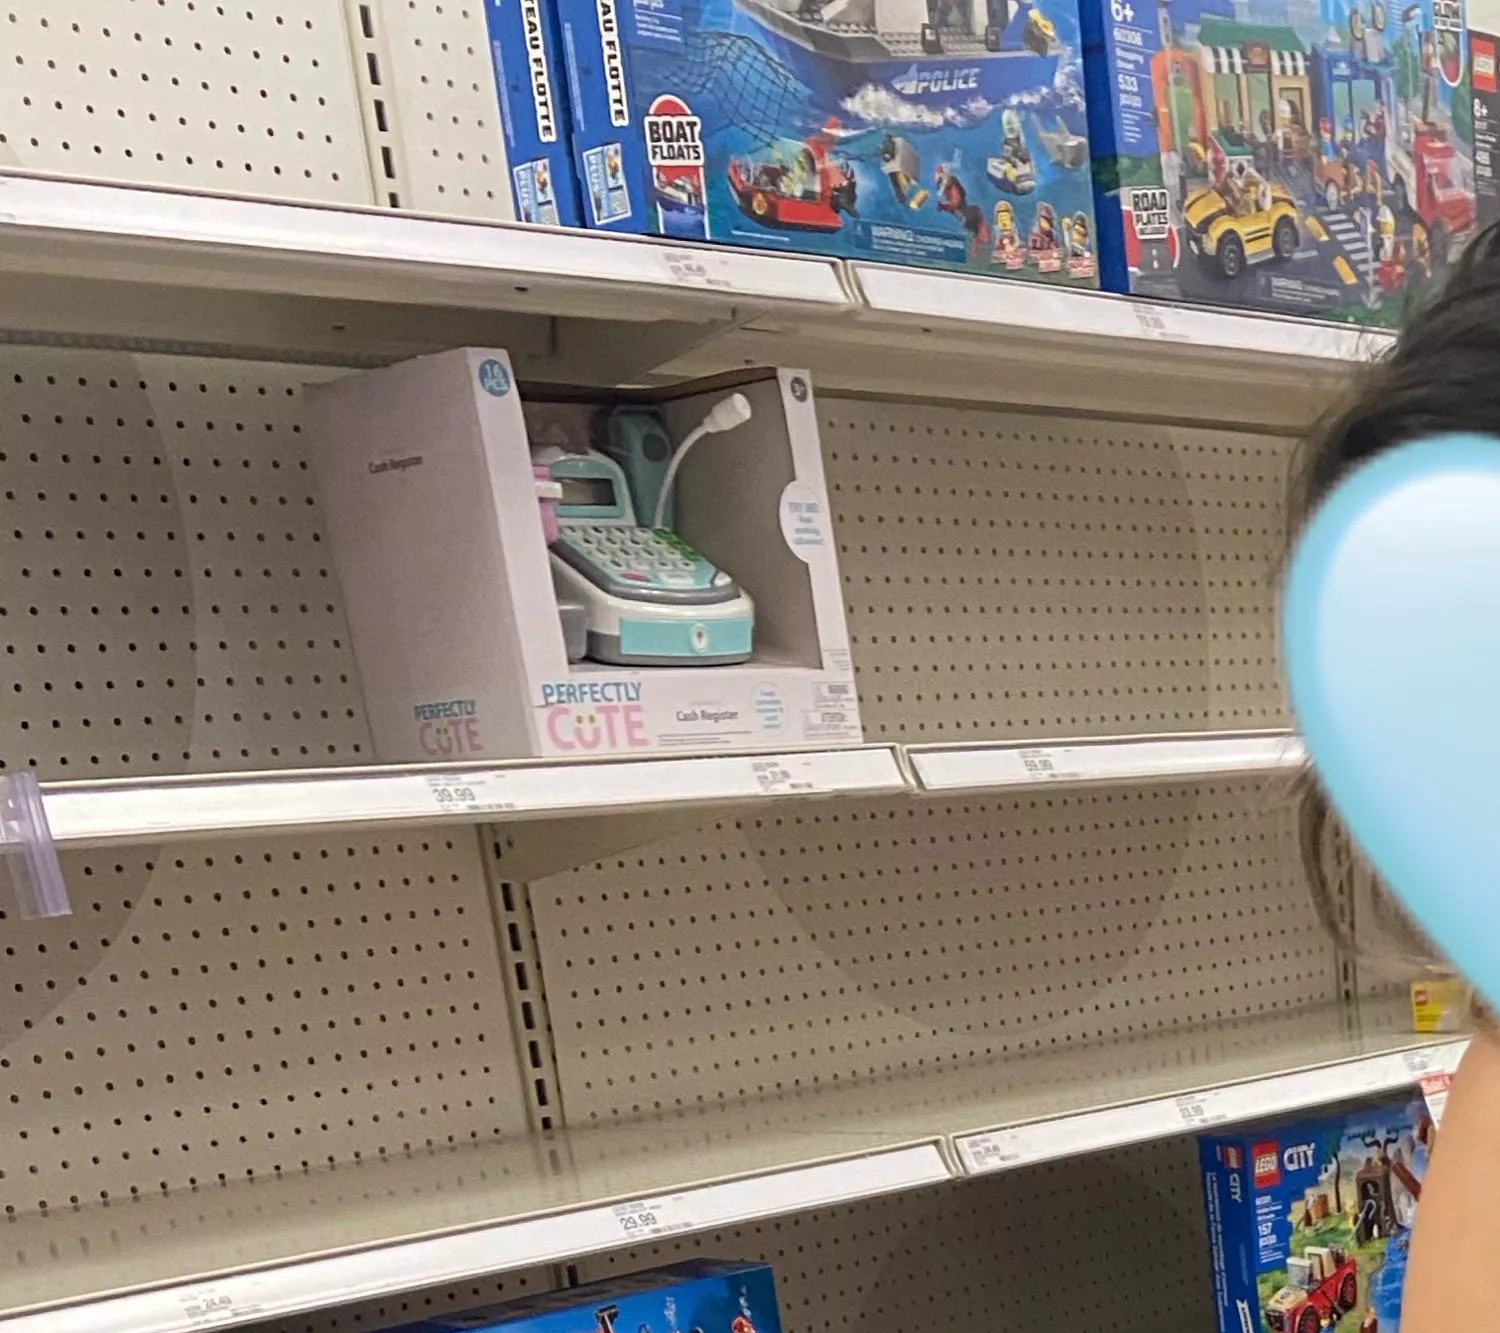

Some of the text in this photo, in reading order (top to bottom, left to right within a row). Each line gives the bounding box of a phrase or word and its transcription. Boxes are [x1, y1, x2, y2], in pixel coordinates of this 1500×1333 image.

[604, 40, 627, 122] FLOTTE
[919, 67, 981, 93] POLICE
[531, 57, 553, 137] FLOTTE
[648, 120, 699, 143] BOAT
[651, 144, 701, 161] FLOATS
[1132, 191, 1168, 212] ROAD
[1135, 211, 1169, 227] PLATES
[541, 682, 642, 706] PERFECTLY
[414, 699, 476, 721] PERFECTLY
[676, 708, 739, 726] Cash Register
[433, 788, 475, 803] 39.99
[1255, 1153, 1277, 1175] LEGO
[1283, 1143, 1316, 1172] CITY
[1229, 1173, 1241, 1203] CITY
[620, 1212, 658, 1231] 29.99
[1259, 1222, 1273, 1237] 157
